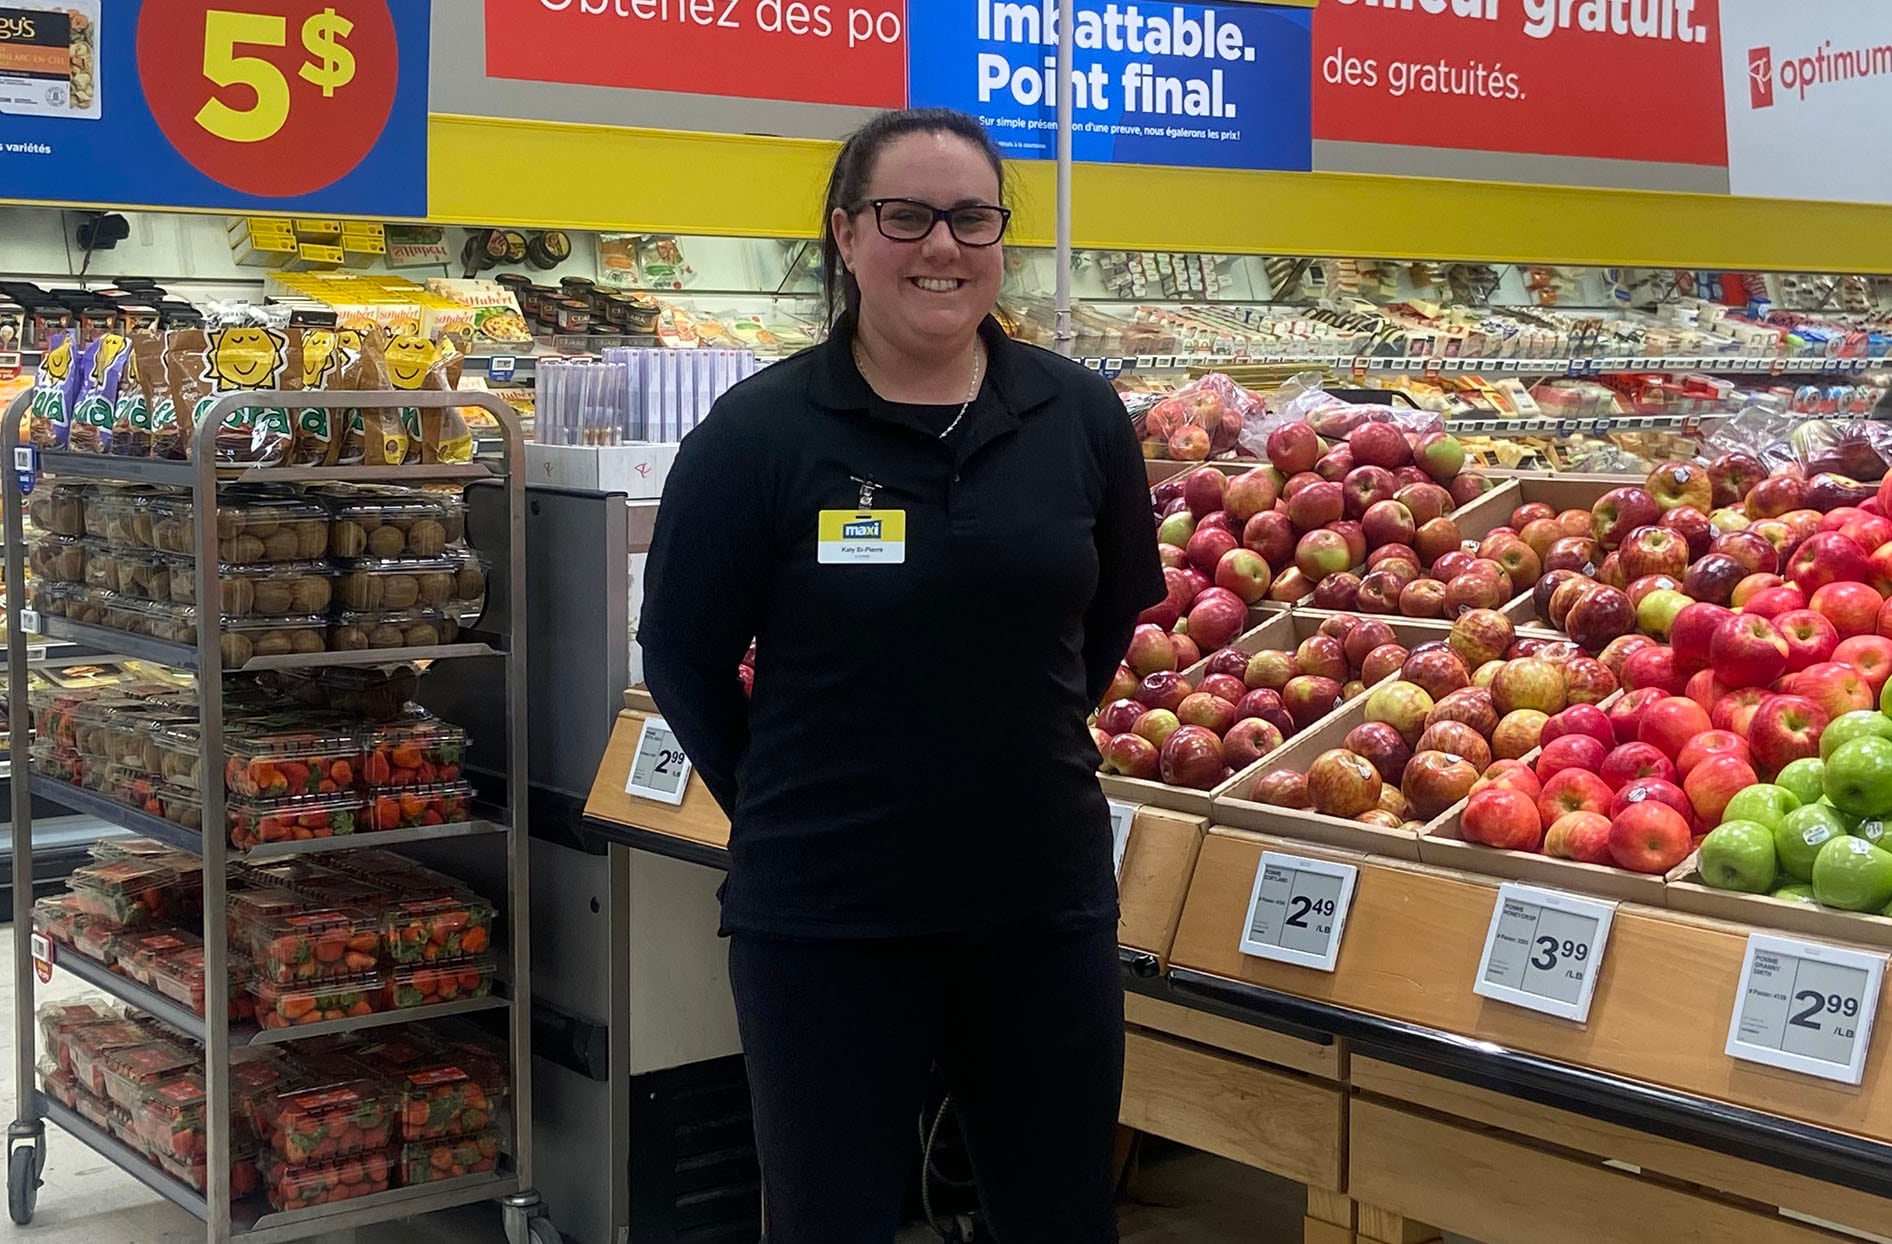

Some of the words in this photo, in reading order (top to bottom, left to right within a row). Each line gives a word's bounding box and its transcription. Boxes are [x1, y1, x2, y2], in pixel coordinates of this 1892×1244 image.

[540, 0, 740, 27] enez
[756, 0, 832, 38] des
[848, 10, 900, 47] po
[978, 0, 1256, 62] Imbattable.
[1523, 0, 1707, 43] gratuit.
[1323, 47, 1378, 86] des
[1388, 60, 1526, 100] gratuités.
[1780, 40, 1892, 101] optimum
[978, 53, 1109, 110] Point
[1122, 62, 1237, 118] final.
[979, 115, 994, 126] Sur
[996, 116, 1026, 129] simple
[1028, 119, 1083, 132] présenon
[1085, 122, 1109, 133] d'une
[1111, 125, 1142, 136] preuve,
[1144, 127, 1164, 136] nous
[1166, 126, 1206, 139] égalerons
[1208, 129, 1220, 139] les
[6, 143, 51, 154] variétés
[845, 522, 880, 536] maxi
[1754, 961, 1781, 971] GRANNY
[1755, 955, 1779, 963] POMME
[1753, 968, 1772, 977] SMITH
[1834, 1027, 1854, 1038] /LB
